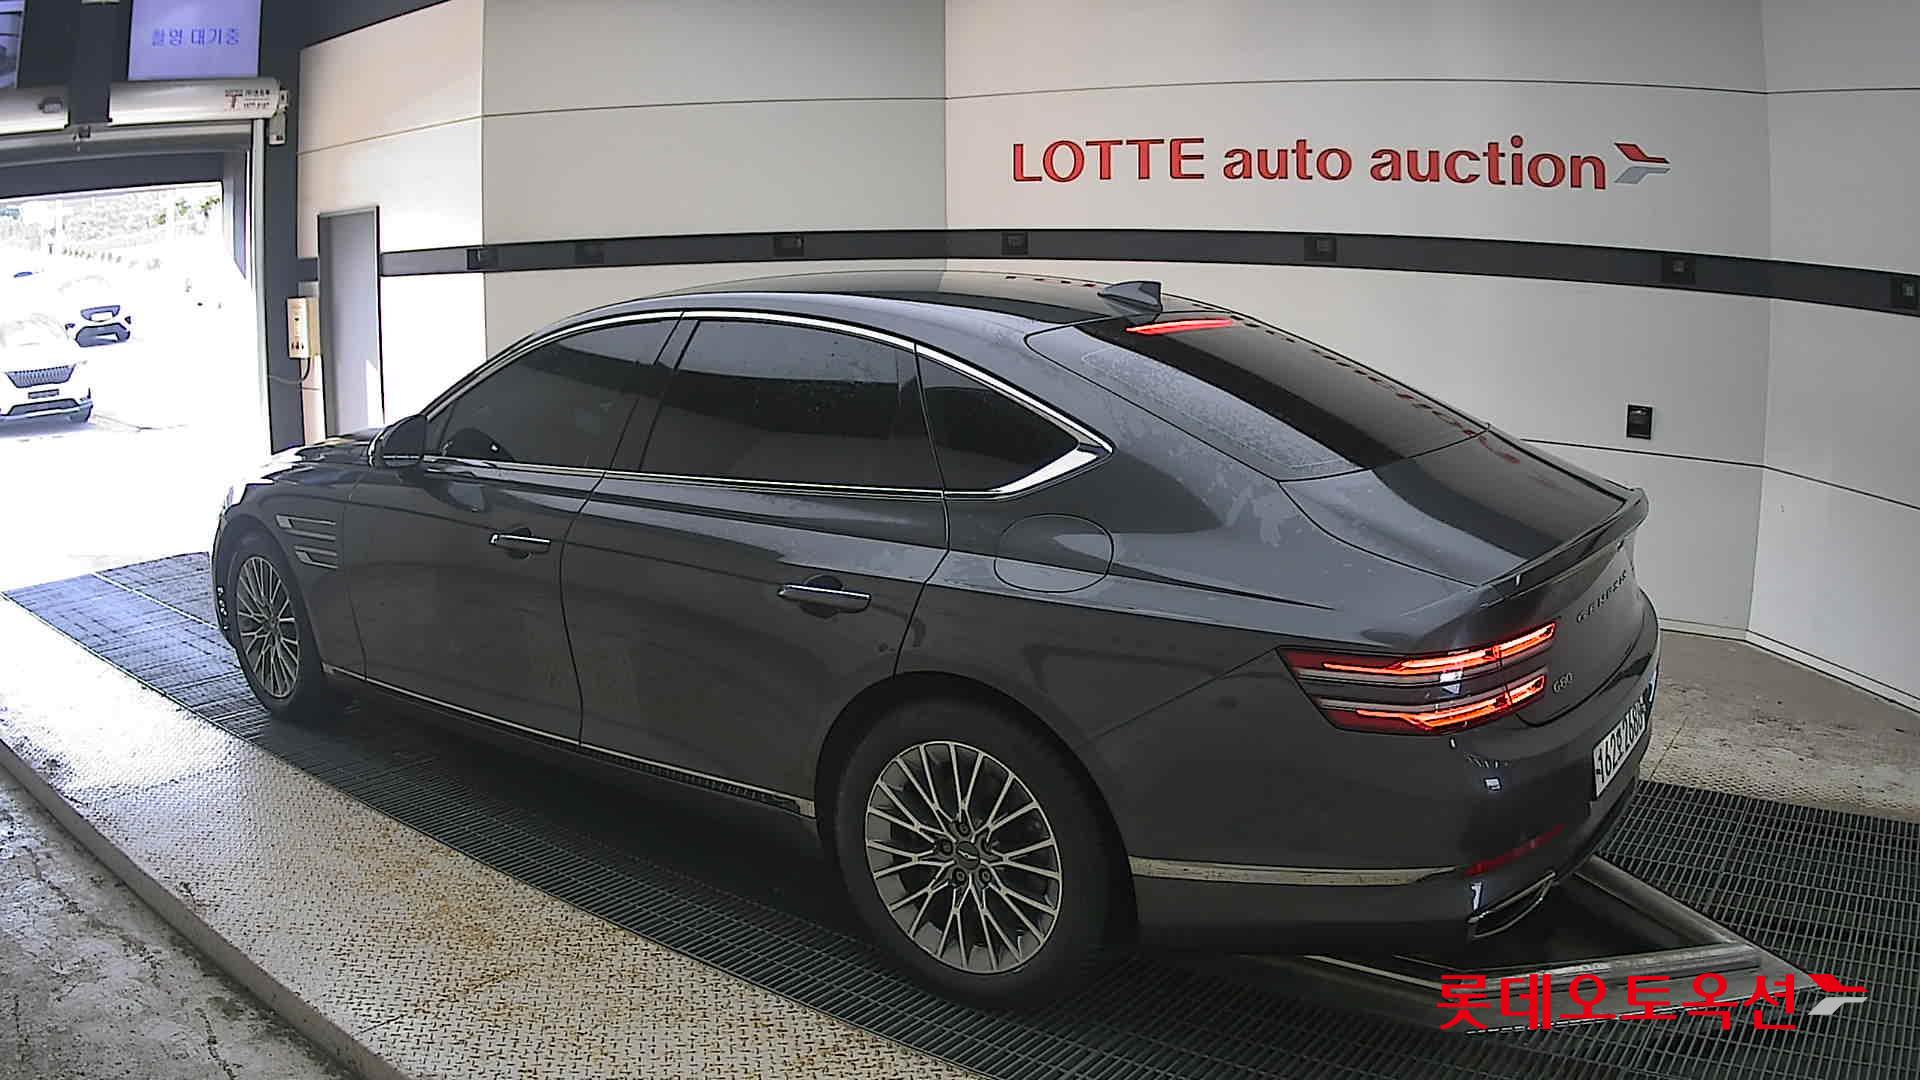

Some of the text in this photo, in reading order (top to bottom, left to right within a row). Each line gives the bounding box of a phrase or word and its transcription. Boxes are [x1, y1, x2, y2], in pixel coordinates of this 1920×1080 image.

[191, 28, 239, 46] 대기중
[1013, 135, 1607, 190] LOTTE auto auction
[1576, 569, 1627, 623] GENESIS
[1552, 671, 1574, 694] G80
